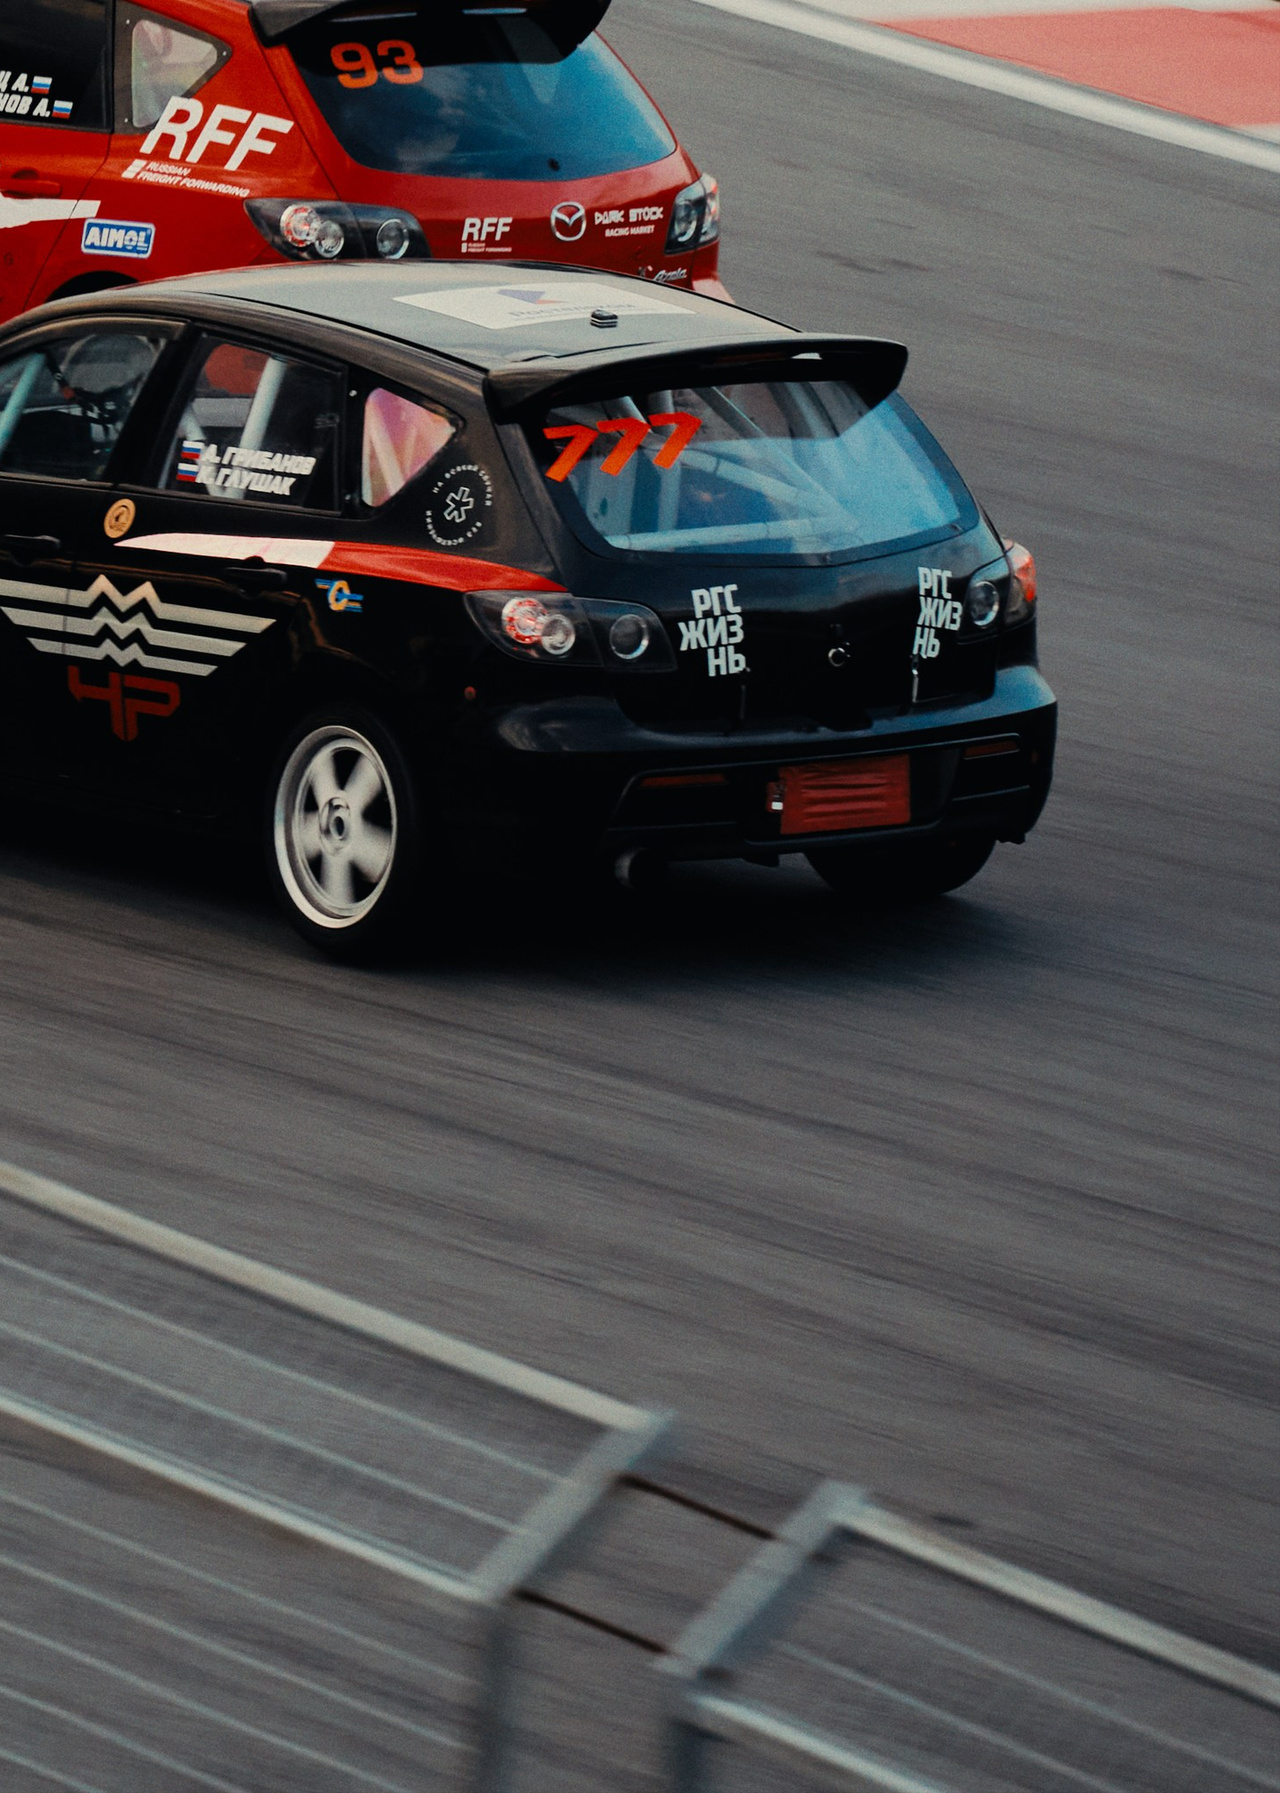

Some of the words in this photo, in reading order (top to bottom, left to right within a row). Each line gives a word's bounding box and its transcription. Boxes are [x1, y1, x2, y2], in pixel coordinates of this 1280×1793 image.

[330, 39, 424, 89] 93
[11, 73, 30, 92] А.
[32, 98, 51, 117] А.
[139, 95, 295, 171] RFF
[137, 171, 182, 185] FREIGHT
[180, 177, 251, 198] FORWARDING
[145, 161, 191, 176] RUSSIAN
[461, 217, 513, 241] RFF
[542, 411, 703, 483] 777
[918, 566, 952, 599] РГС
[691, 584, 742, 619] РГС
[917, 596, 963, 631] ЖИЗ
[677, 614, 744, 651] ЖИЗ
[912, 626, 940, 659] НЬ
[707, 645, 746, 677] НЬ
